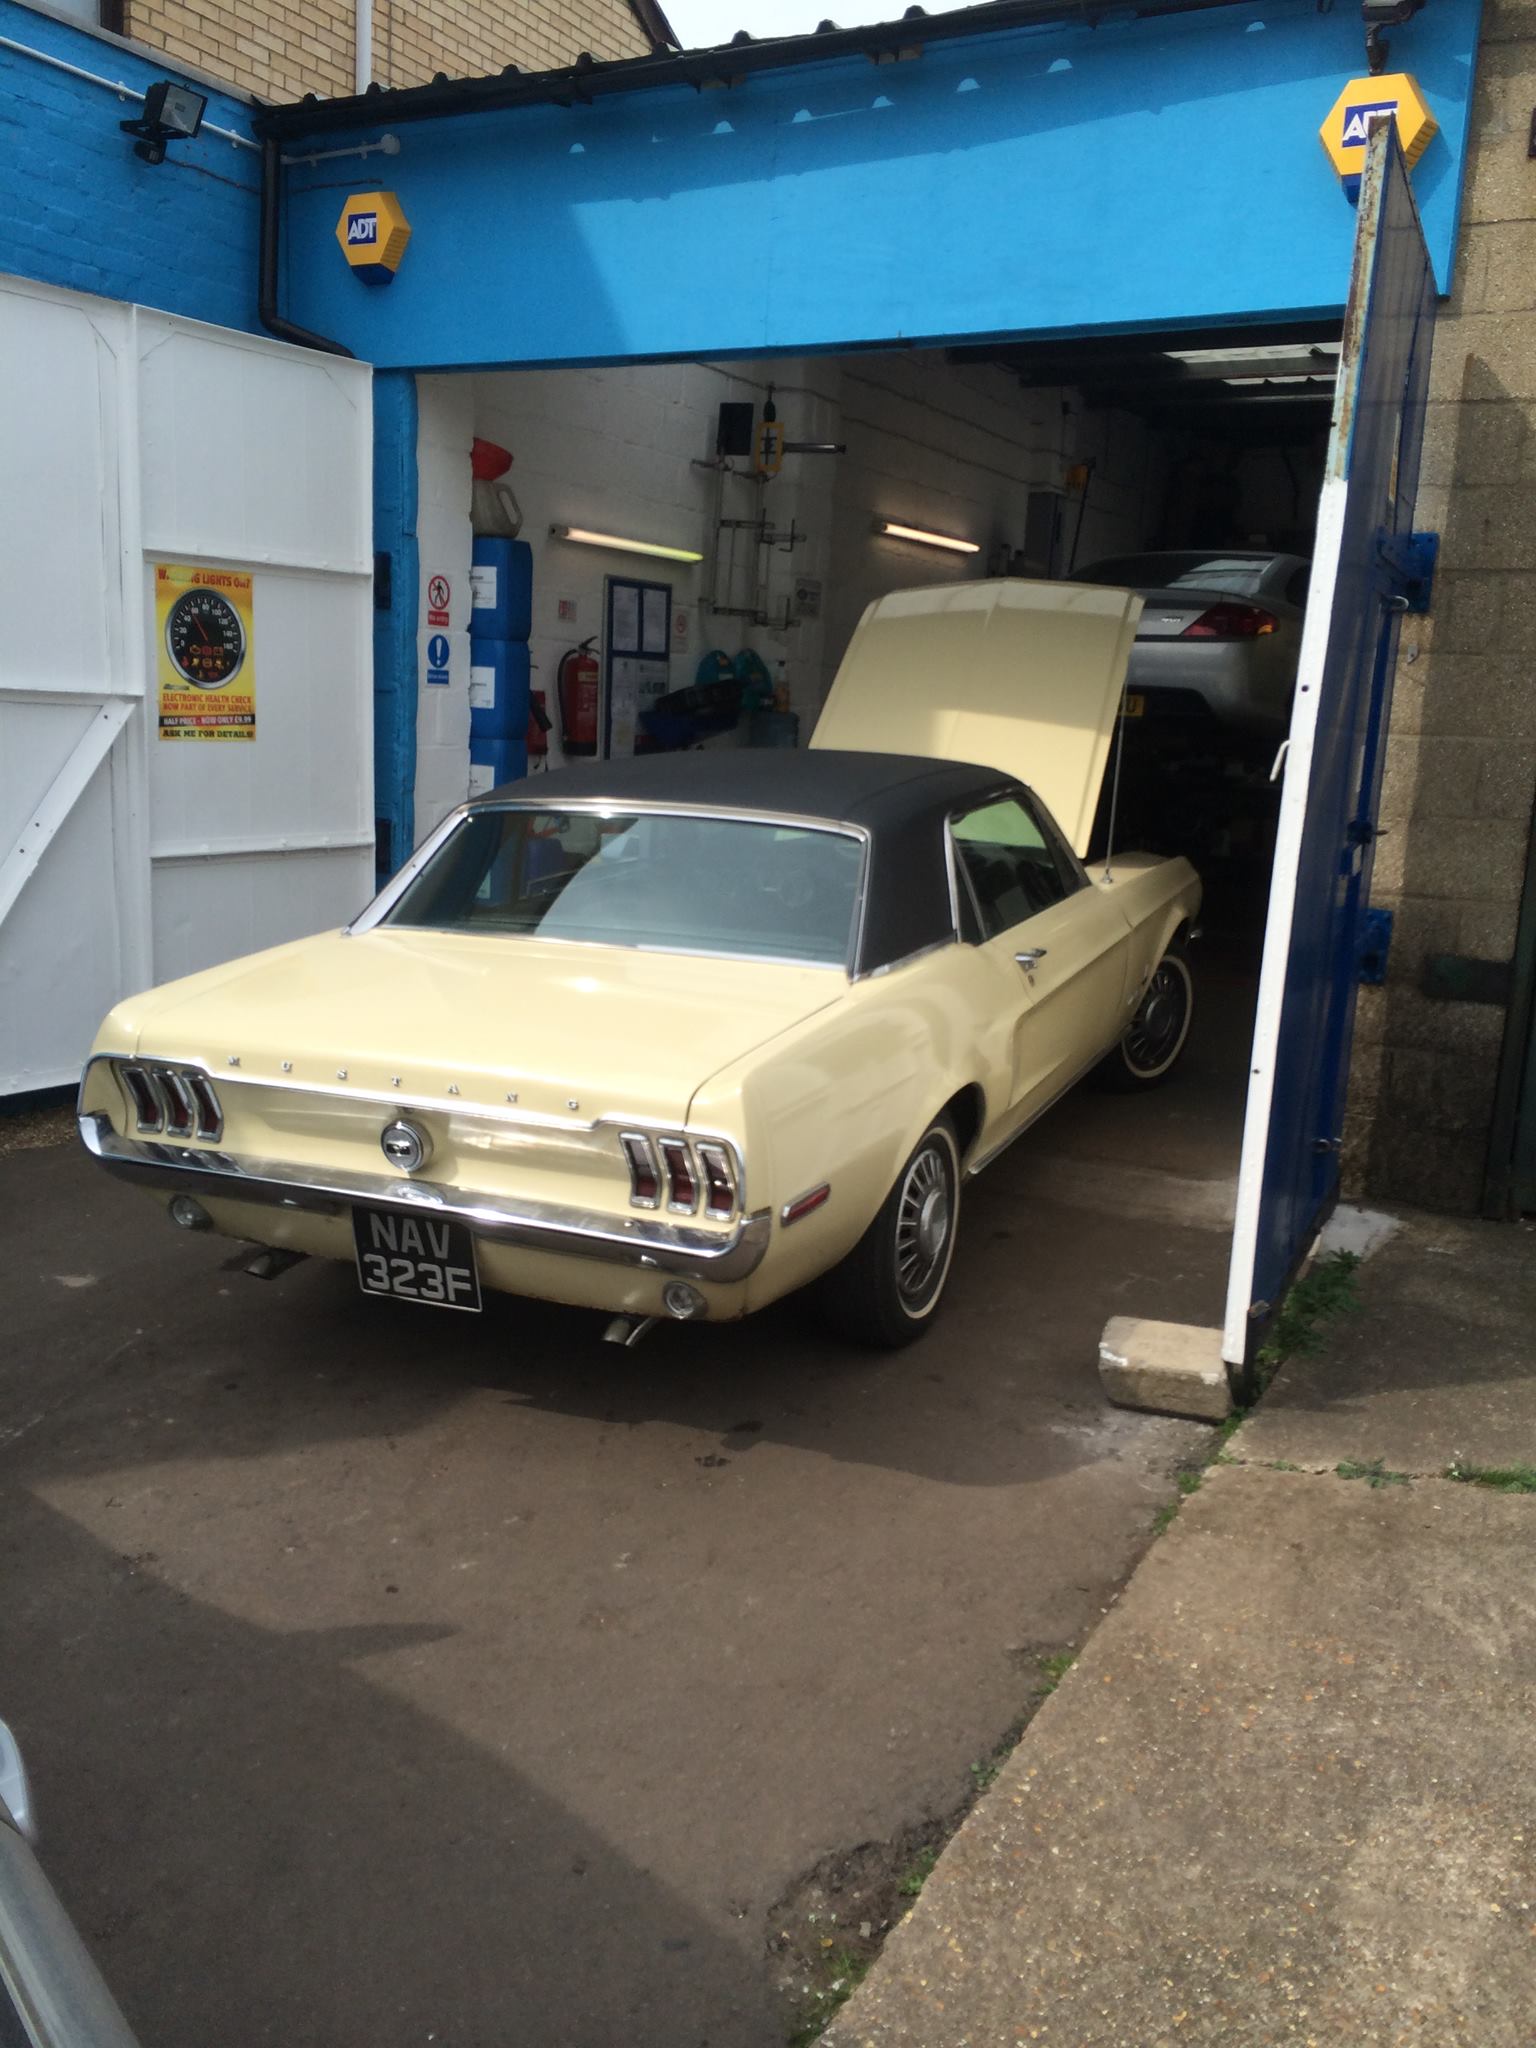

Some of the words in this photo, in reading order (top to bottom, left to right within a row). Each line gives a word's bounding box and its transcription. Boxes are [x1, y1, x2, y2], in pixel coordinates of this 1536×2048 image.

[348, 217, 377, 240] ADT
[202, 574, 231, 587] LIGHTS
[163, 693, 204, 702] ELECTRONIC
[206, 694, 230, 703] HEALTH
[231, 695, 251, 704] CHECK
[180, 703, 195, 711] PART
[208, 704, 225, 712] EVERY
[228, 705, 252, 713] SERVICE
[164, 717, 178, 725] HALF
[180, 717, 196, 725] PRICE
[217, 716, 233, 724] ONLY
[228, 1055, 579, 1110] MUSTANG
[370, 1213, 450, 1259] NAV
[363, 1253, 472, 1301] 323F
